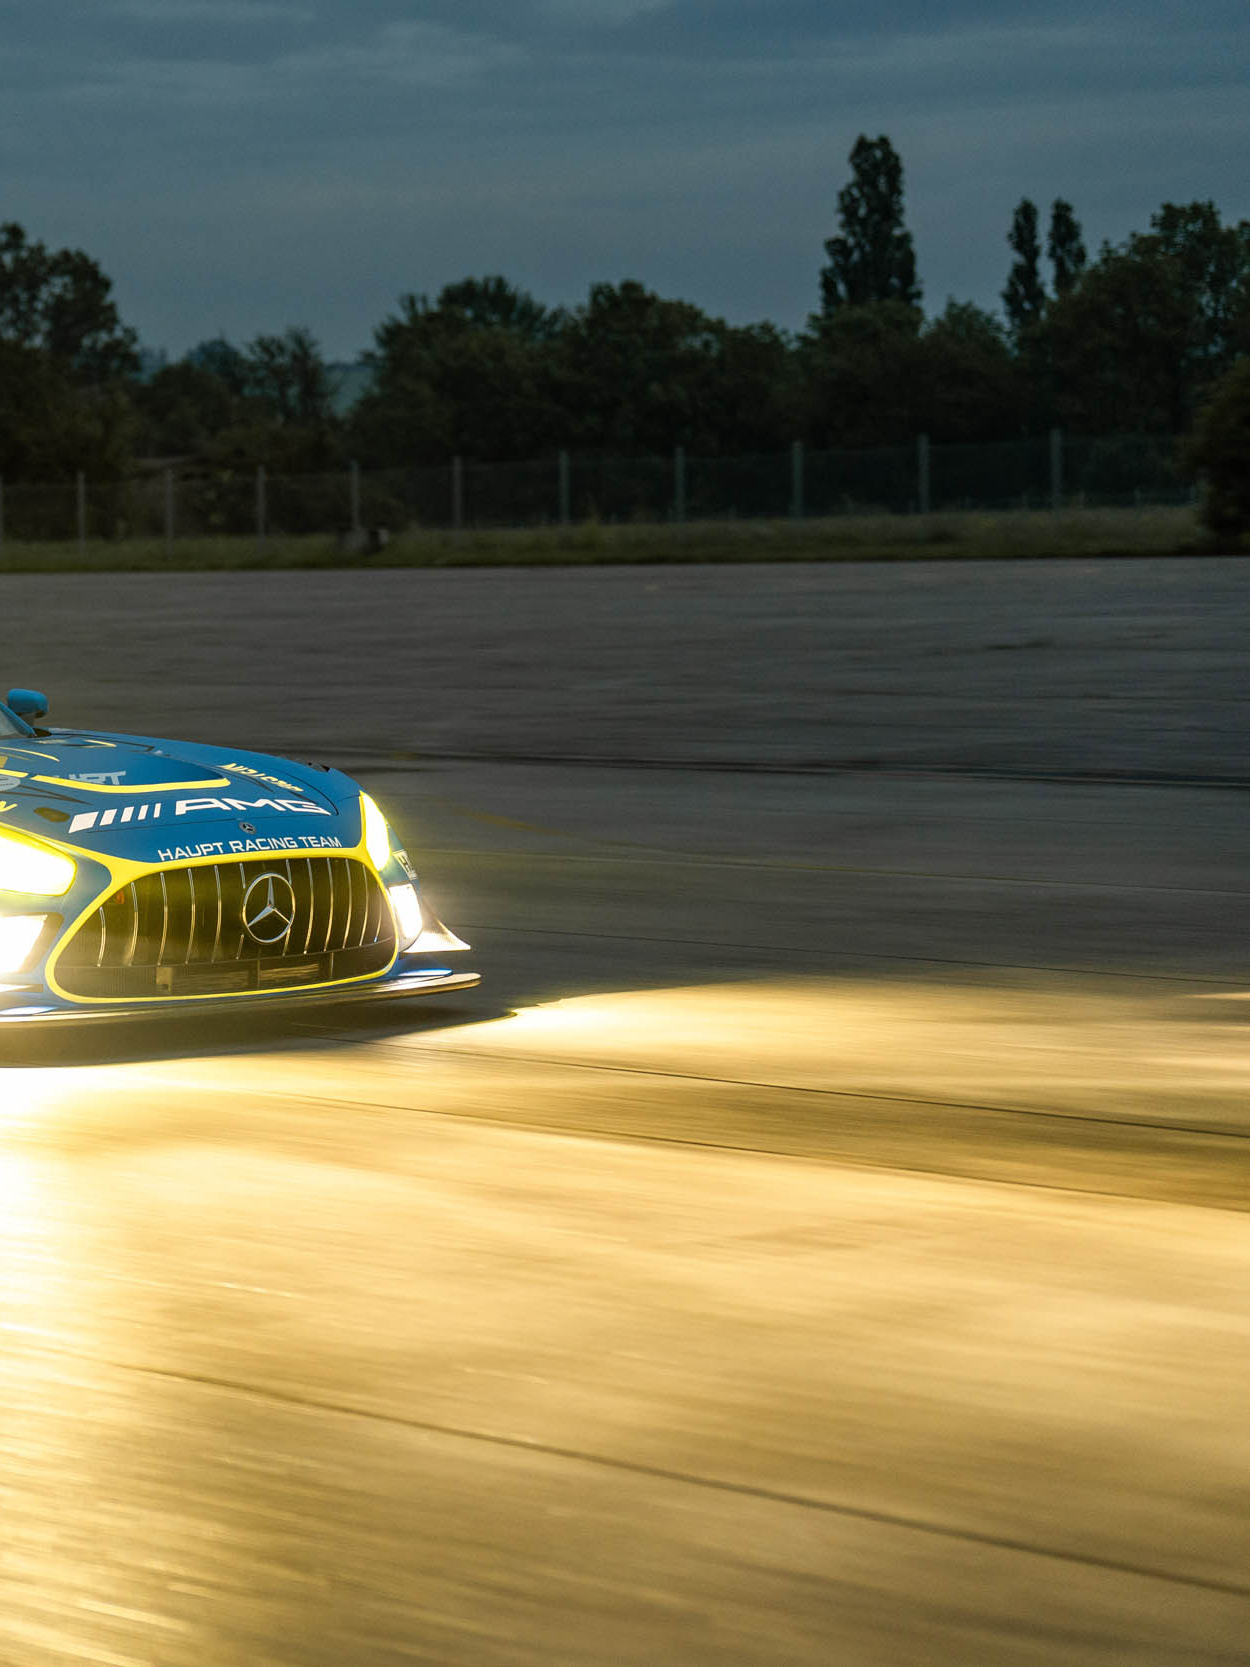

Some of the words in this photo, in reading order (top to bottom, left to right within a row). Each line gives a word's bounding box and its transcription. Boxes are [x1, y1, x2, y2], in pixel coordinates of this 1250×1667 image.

[175, 798, 332, 816] AMG
[157, 842, 224, 861] HAUPT
[229, 837, 298, 853] RACING
[297, 836, 343, 848] TEAM
